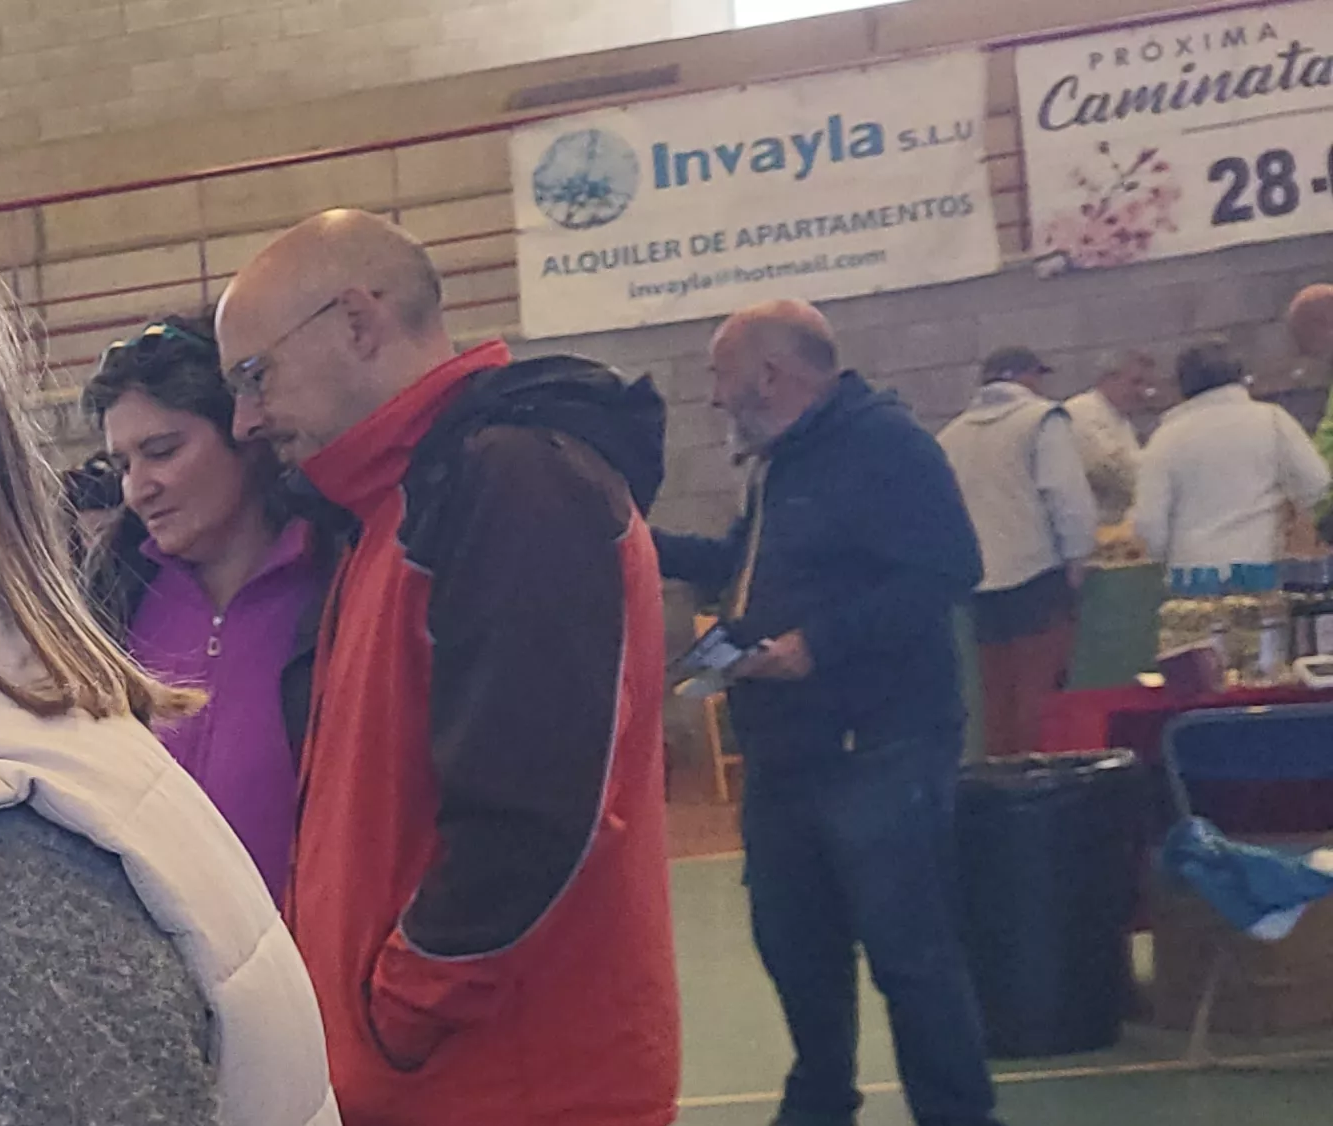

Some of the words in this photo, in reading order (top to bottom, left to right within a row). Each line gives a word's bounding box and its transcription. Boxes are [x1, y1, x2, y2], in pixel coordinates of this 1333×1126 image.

[1038, 40, 1333, 132] Caminata
[651, 113, 886, 189] Invayla
[540, 238, 682, 278] ALQUILER
[690, 230, 726, 255] DE
[735, 193, 975, 248] APARTAMENTOS
[628, 247, 887, 299] invayla@hotmail.com
